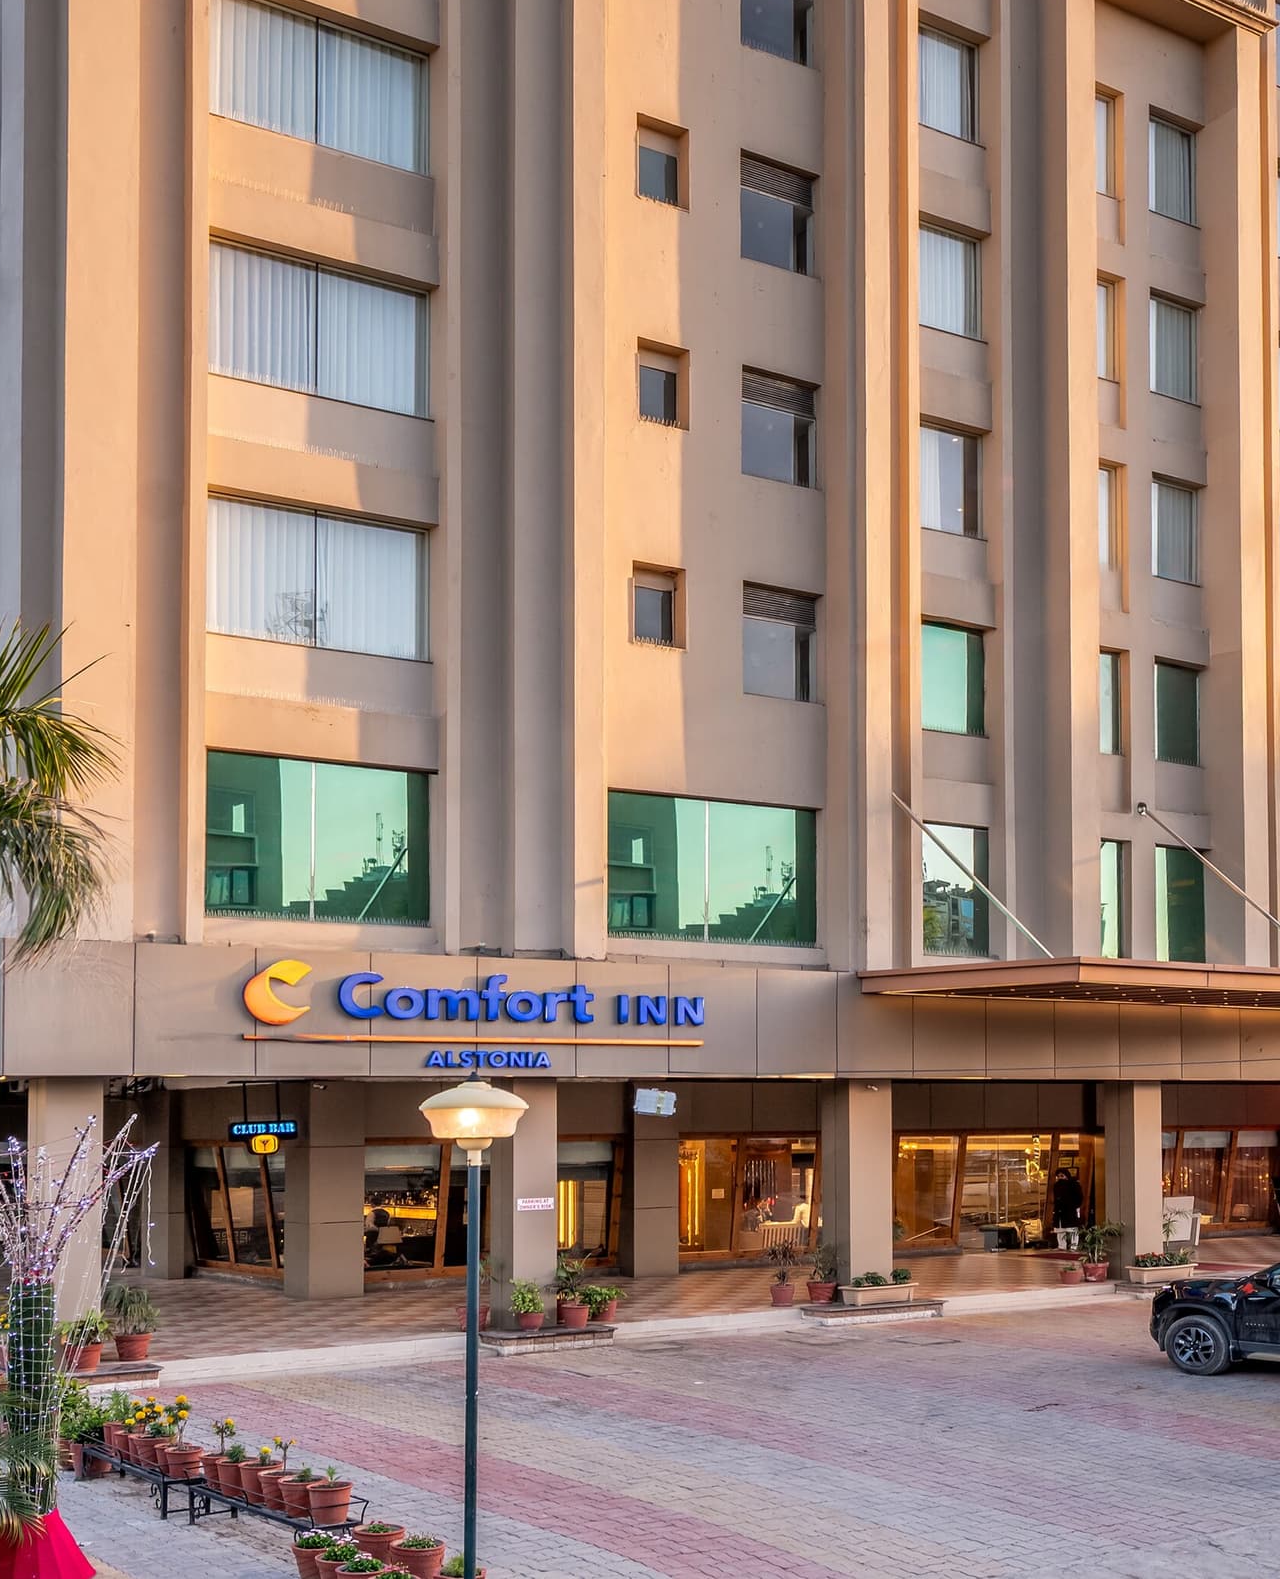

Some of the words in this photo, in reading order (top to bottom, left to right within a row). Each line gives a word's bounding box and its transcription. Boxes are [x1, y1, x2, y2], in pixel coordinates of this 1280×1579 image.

[337, 972, 595, 1024] Comfort
[616, 994, 705, 1026] INN
[426, 1050, 552, 1069] ALSTONIA
[232, 1123, 266, 1135] CLUB
[268, 1122, 296, 1133] BAR
